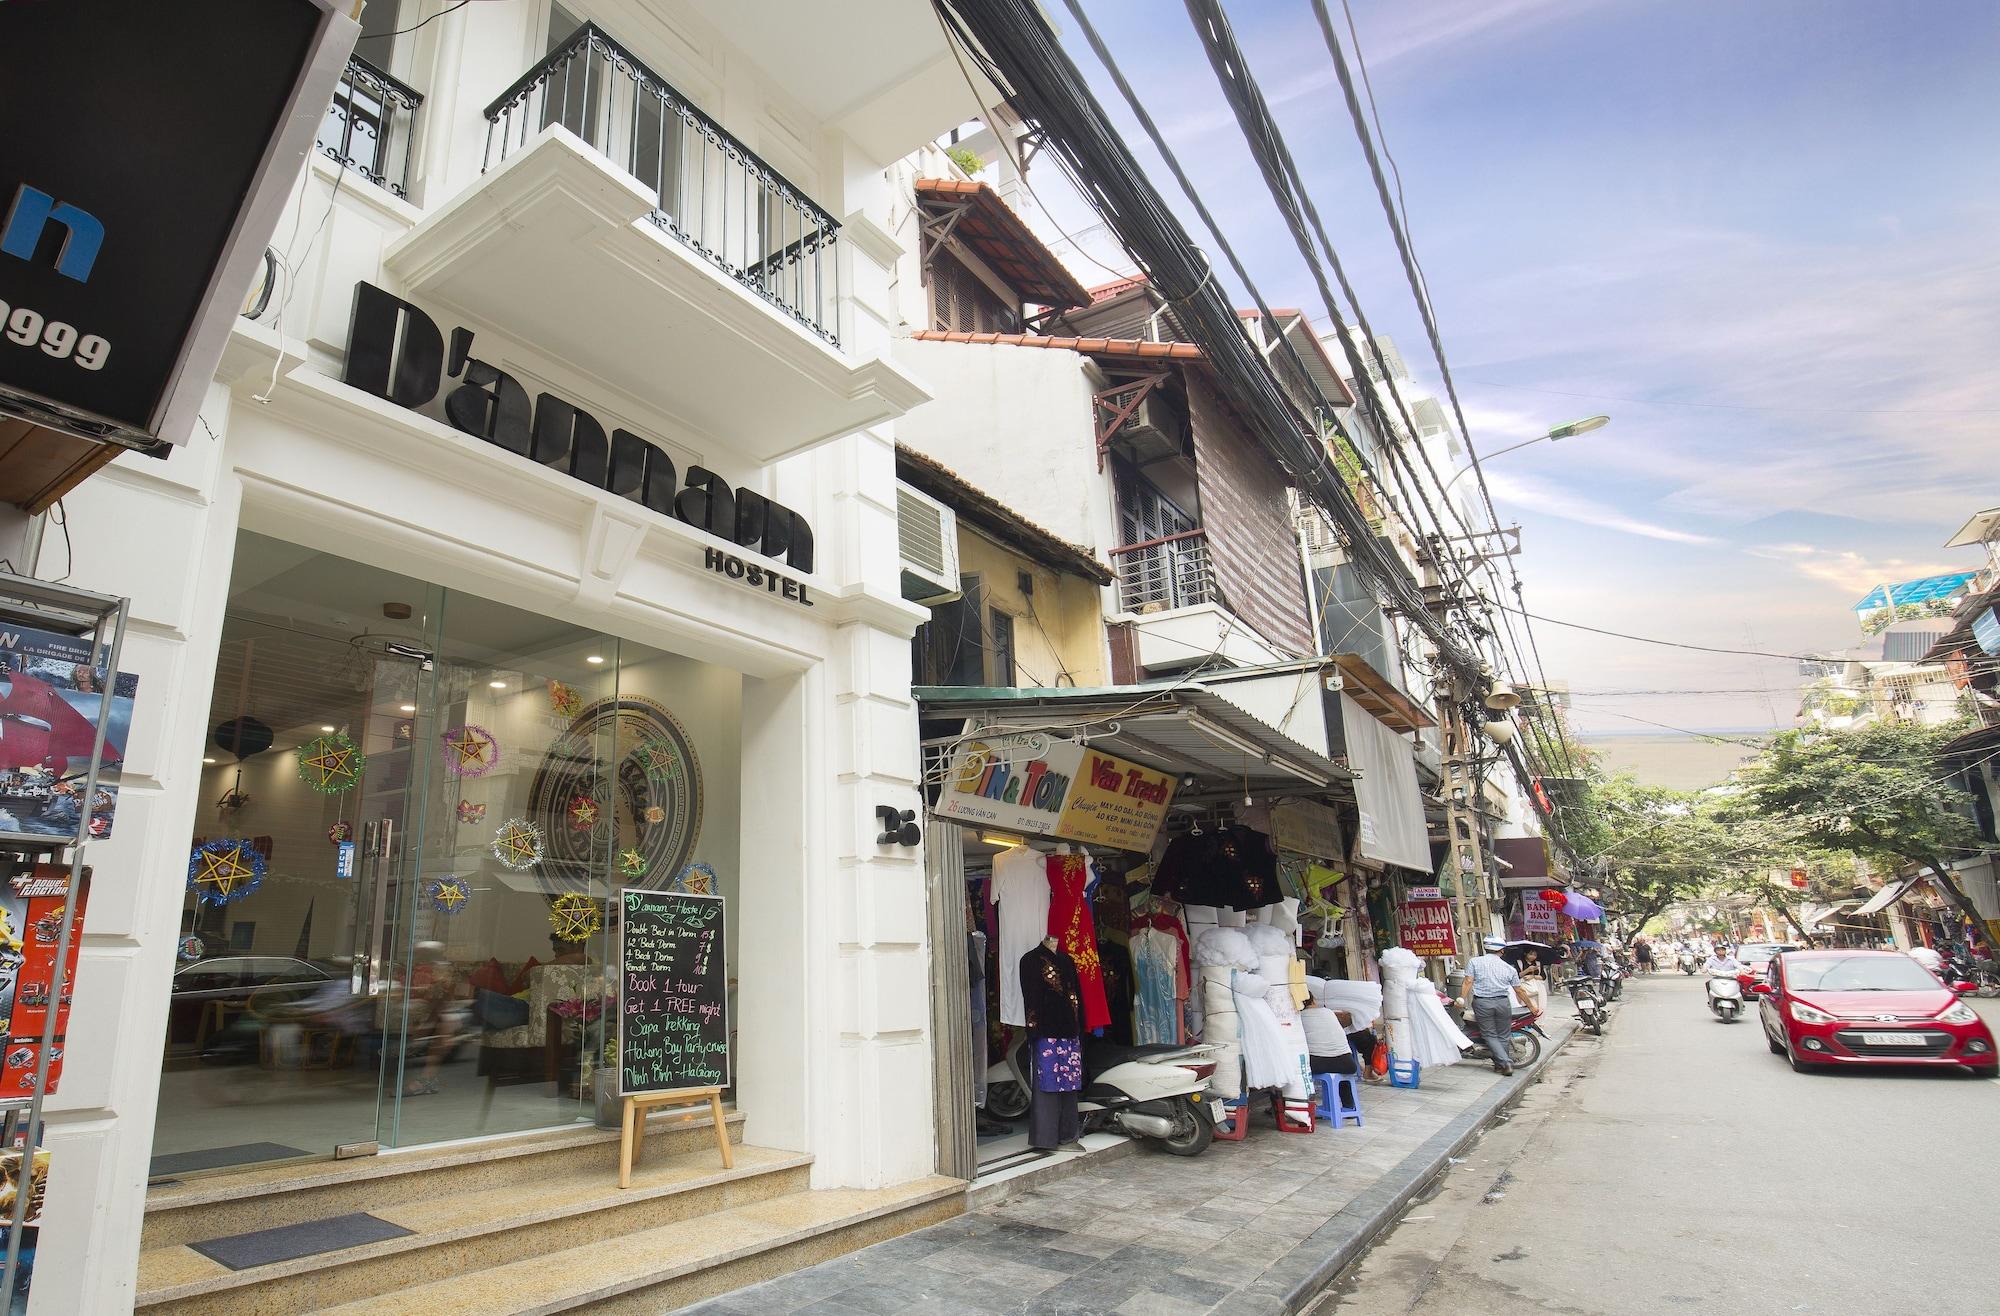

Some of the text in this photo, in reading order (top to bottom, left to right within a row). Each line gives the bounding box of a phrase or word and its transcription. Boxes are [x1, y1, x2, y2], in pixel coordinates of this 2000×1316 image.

[0, 299, 111, 371] 999
[340, 279, 814, 575] D'annam
[704, 545, 814, 606] HOSTEL
[1019, 760, 1071, 813] TOM
[948, 800, 960, 813] 26
[337, 850, 346, 873] PUSH
[670, 899, 704, 915] Hostel
[1427, 906, 1448, 924] BAO
[625, 921, 648, 934] Double
[651, 925, 666, 936] Bed
[668, 928, 674, 936] in
[677, 927, 697, 938] Dorm
[657, 939, 676, 949] Dorm
[654, 951, 674, 961] Dorm
[651, 962, 671, 971] Dorm
[628, 973, 704, 993] Book 1 tour
[624, 997, 720, 1024] Get 1 FREE night
[630, 1013, 701, 1039] Sapa Trekking
